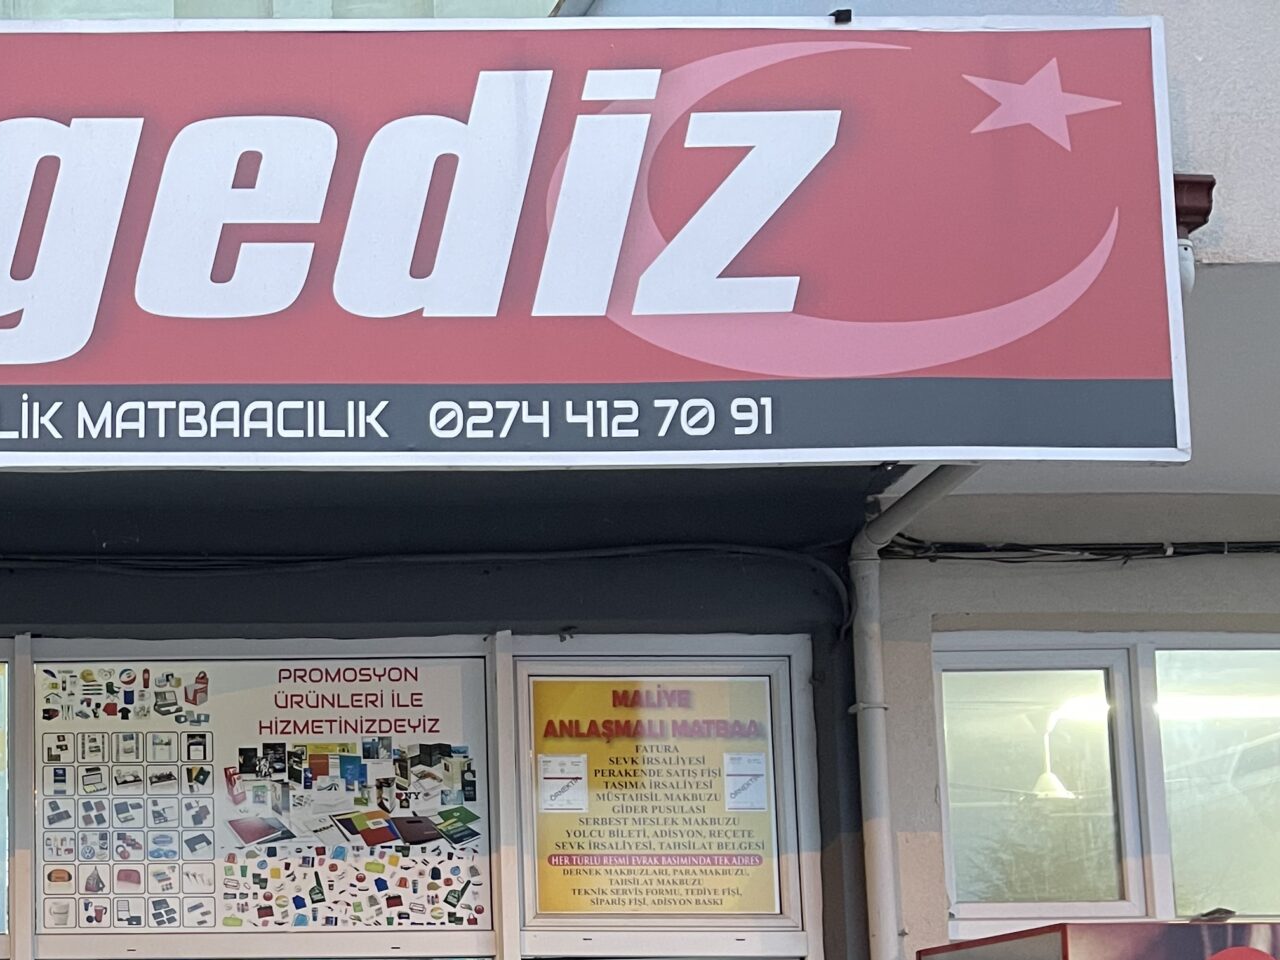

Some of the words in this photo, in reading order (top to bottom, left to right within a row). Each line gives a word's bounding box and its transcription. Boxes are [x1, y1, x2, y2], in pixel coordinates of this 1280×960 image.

[76, 398, 390, 441] MATBAACILIK
[428, 399, 551, 441] 0274
[564, 399, 640, 440] 412
[653, 397, 715, 440] 70
[729, 396, 774, 437] 91
[278, 666, 419, 683] PROMOSYON
[274, 691, 385, 709] ÜRÜNLERİ
[391, 691, 424, 708] İLE
[611, 684, 692, 709] MALİYE
[259, 716, 441, 735] HİZMETİNİZDEYİZ
[543, 719, 665, 743] ANLAŞMALI
[671, 719, 761, 738] MATBAA
[635, 745, 679, 753] FATURA
[609, 757, 639, 765] SEVK
[642, 755, 706, 765] İRSALİYESİ
[594, 769, 664, 777] PERAKENDE
[666, 769, 698, 779] SATIŞ
[700, 767, 722, 779] FİŞİ
[603, 781, 646, 791] TAŞIMA
[649, 779, 713, 789] İRSALİYESİ
[596, 791, 661, 801] MÜSTAHSİL
[664, 793, 721, 801] MAKBUZU
[612, 803, 649, 814] GİDER
[652, 805, 706, 814] PUSULASI
[578, 817, 629, 826] SERBEST
[632, 817, 679, 826] MESLEK
[682, 817, 740, 826] MAKBUZU
[566, 829, 606, 838] YOLCU
[709, 829, 754, 840] REÇETE
[555, 842, 585, 850] SEVK
[659, 840, 714, 850] TAHSİLAT
[717, 840, 765, 851] BELGESİ
[551, 856, 570, 865] HER
[603, 854, 630, 865] RESMİ
[631, 856, 660, 865] EVRAK
[661, 856, 712, 865] BASIMINDA
[713, 856, 731, 865] TEK
[731, 856, 760, 865] ADRES
[563, 868, 602, 876] DERNEK
[673, 868, 697, 876] PARA
[609, 877, 654, 886] TAHSİLAT
[656, 878, 704, 886] MAKBUZU
[571, 887, 608, 896] TEKNİK
[610, 887, 643, 896] SERVİS
[685, 887, 720, 896] TEDİYE
[590, 897, 626, 906] SİPARİŞ
[651, 897, 693, 906] ADİSYON
[695, 898, 724, 906] BASKI
